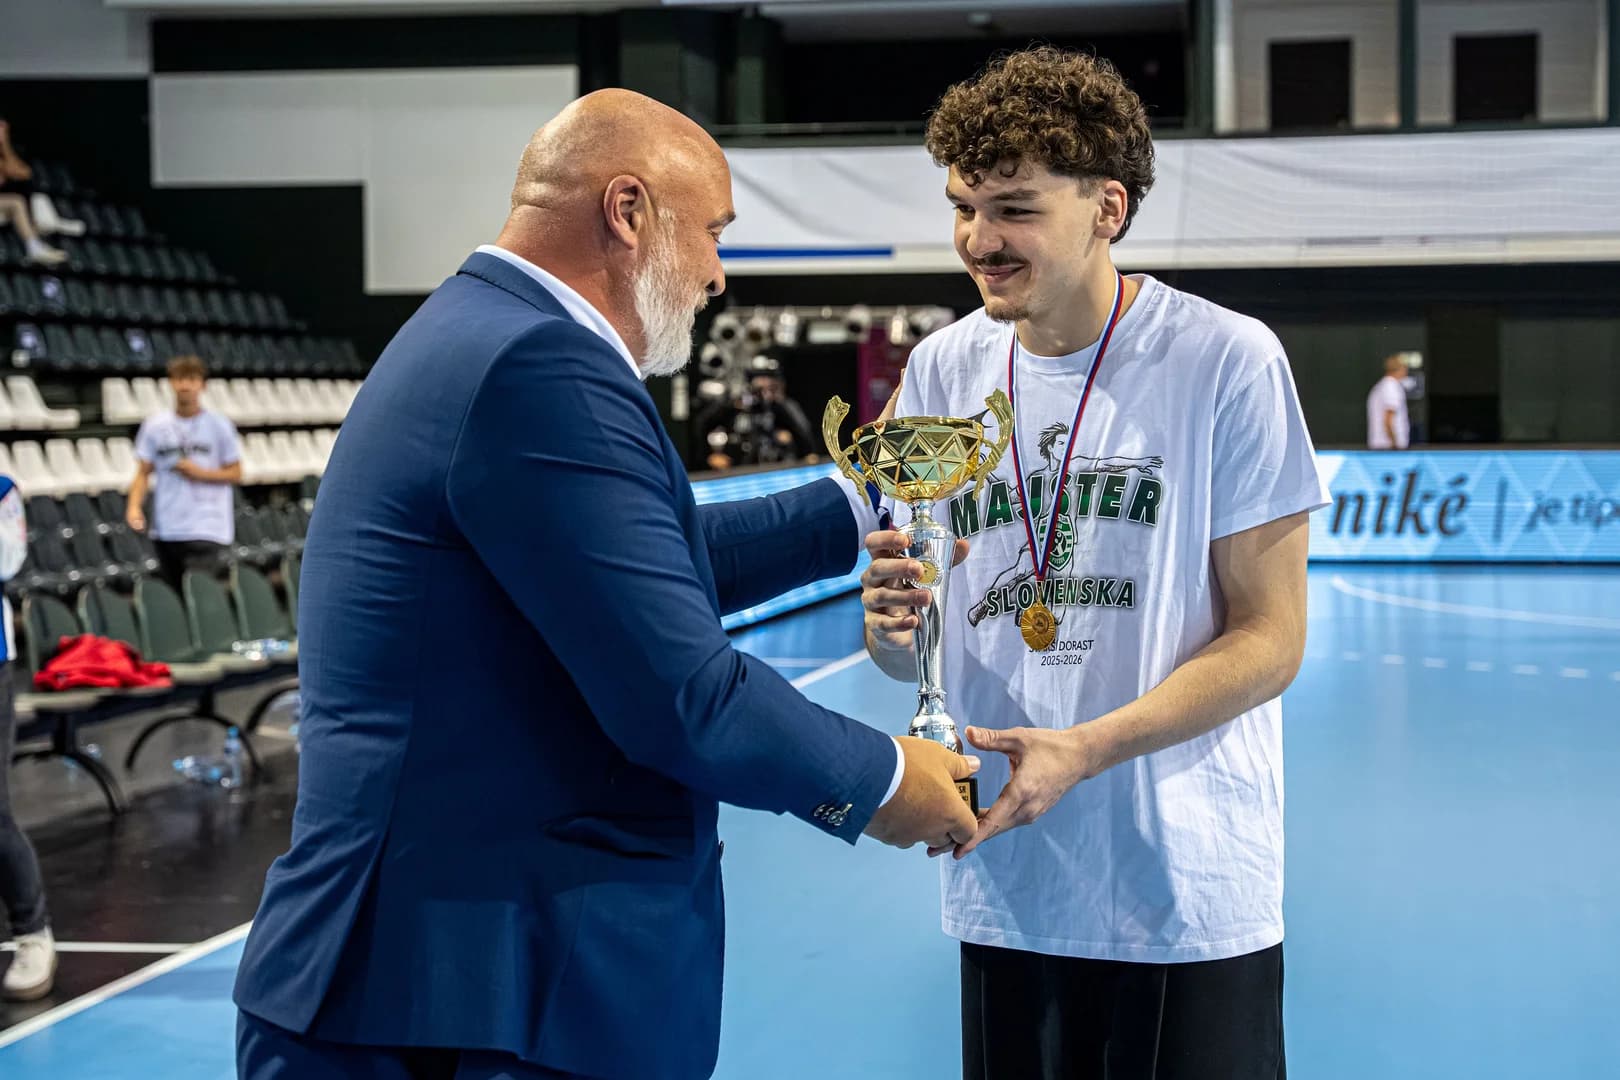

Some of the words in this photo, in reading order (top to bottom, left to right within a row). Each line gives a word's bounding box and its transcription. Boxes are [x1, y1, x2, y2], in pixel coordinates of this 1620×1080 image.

[949, 471, 1162, 540] MAJSTER
[1330, 470, 1467, 536] niké
[985, 577, 1135, 617] SLOVENSKA
[1041, 655, 1082, 666] 2025-2026
[1058, 640, 1094, 652] DORAST
